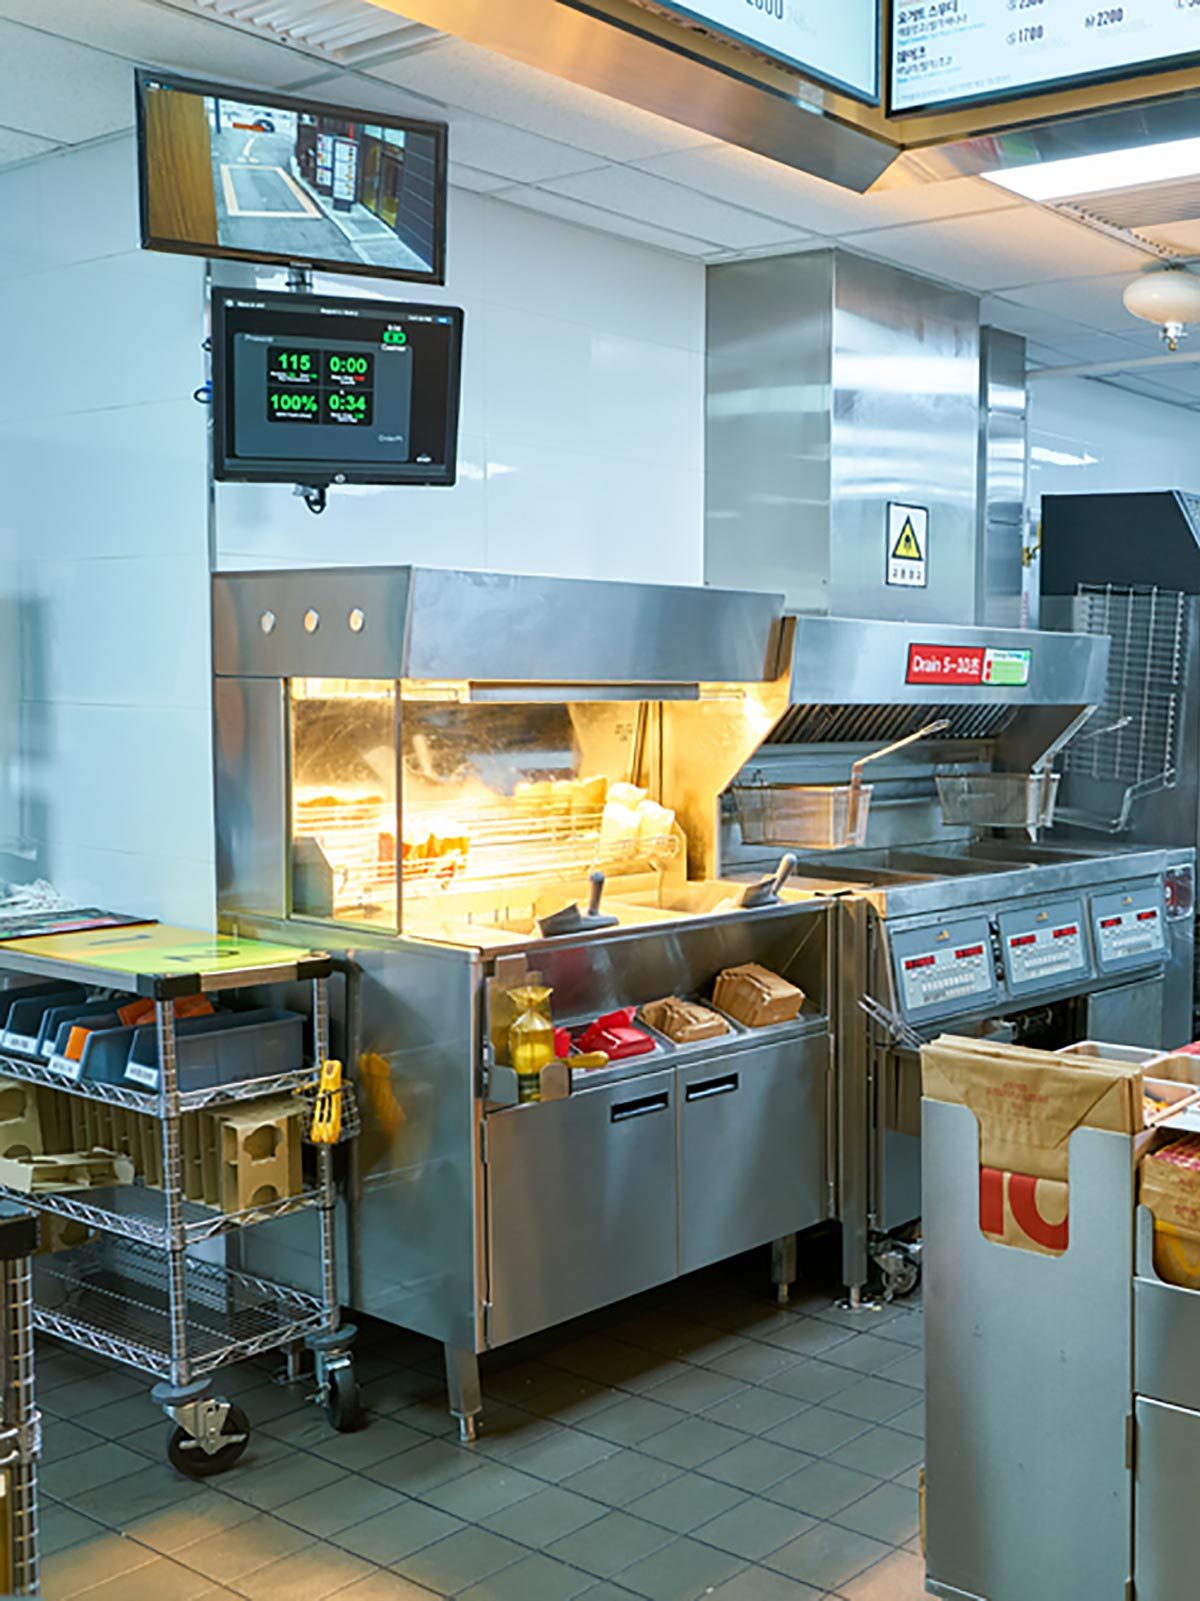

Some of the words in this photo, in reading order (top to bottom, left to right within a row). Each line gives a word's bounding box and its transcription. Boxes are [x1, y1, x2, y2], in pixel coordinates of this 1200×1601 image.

[1019, 25, 1043, 42] 1700
[278, 353, 311, 371] 115
[329, 356, 367, 374] 0:00
[270, 394, 318, 412] 100%
[329, 394, 367, 412] 0:34
[912, 655, 941, 673] Drain
